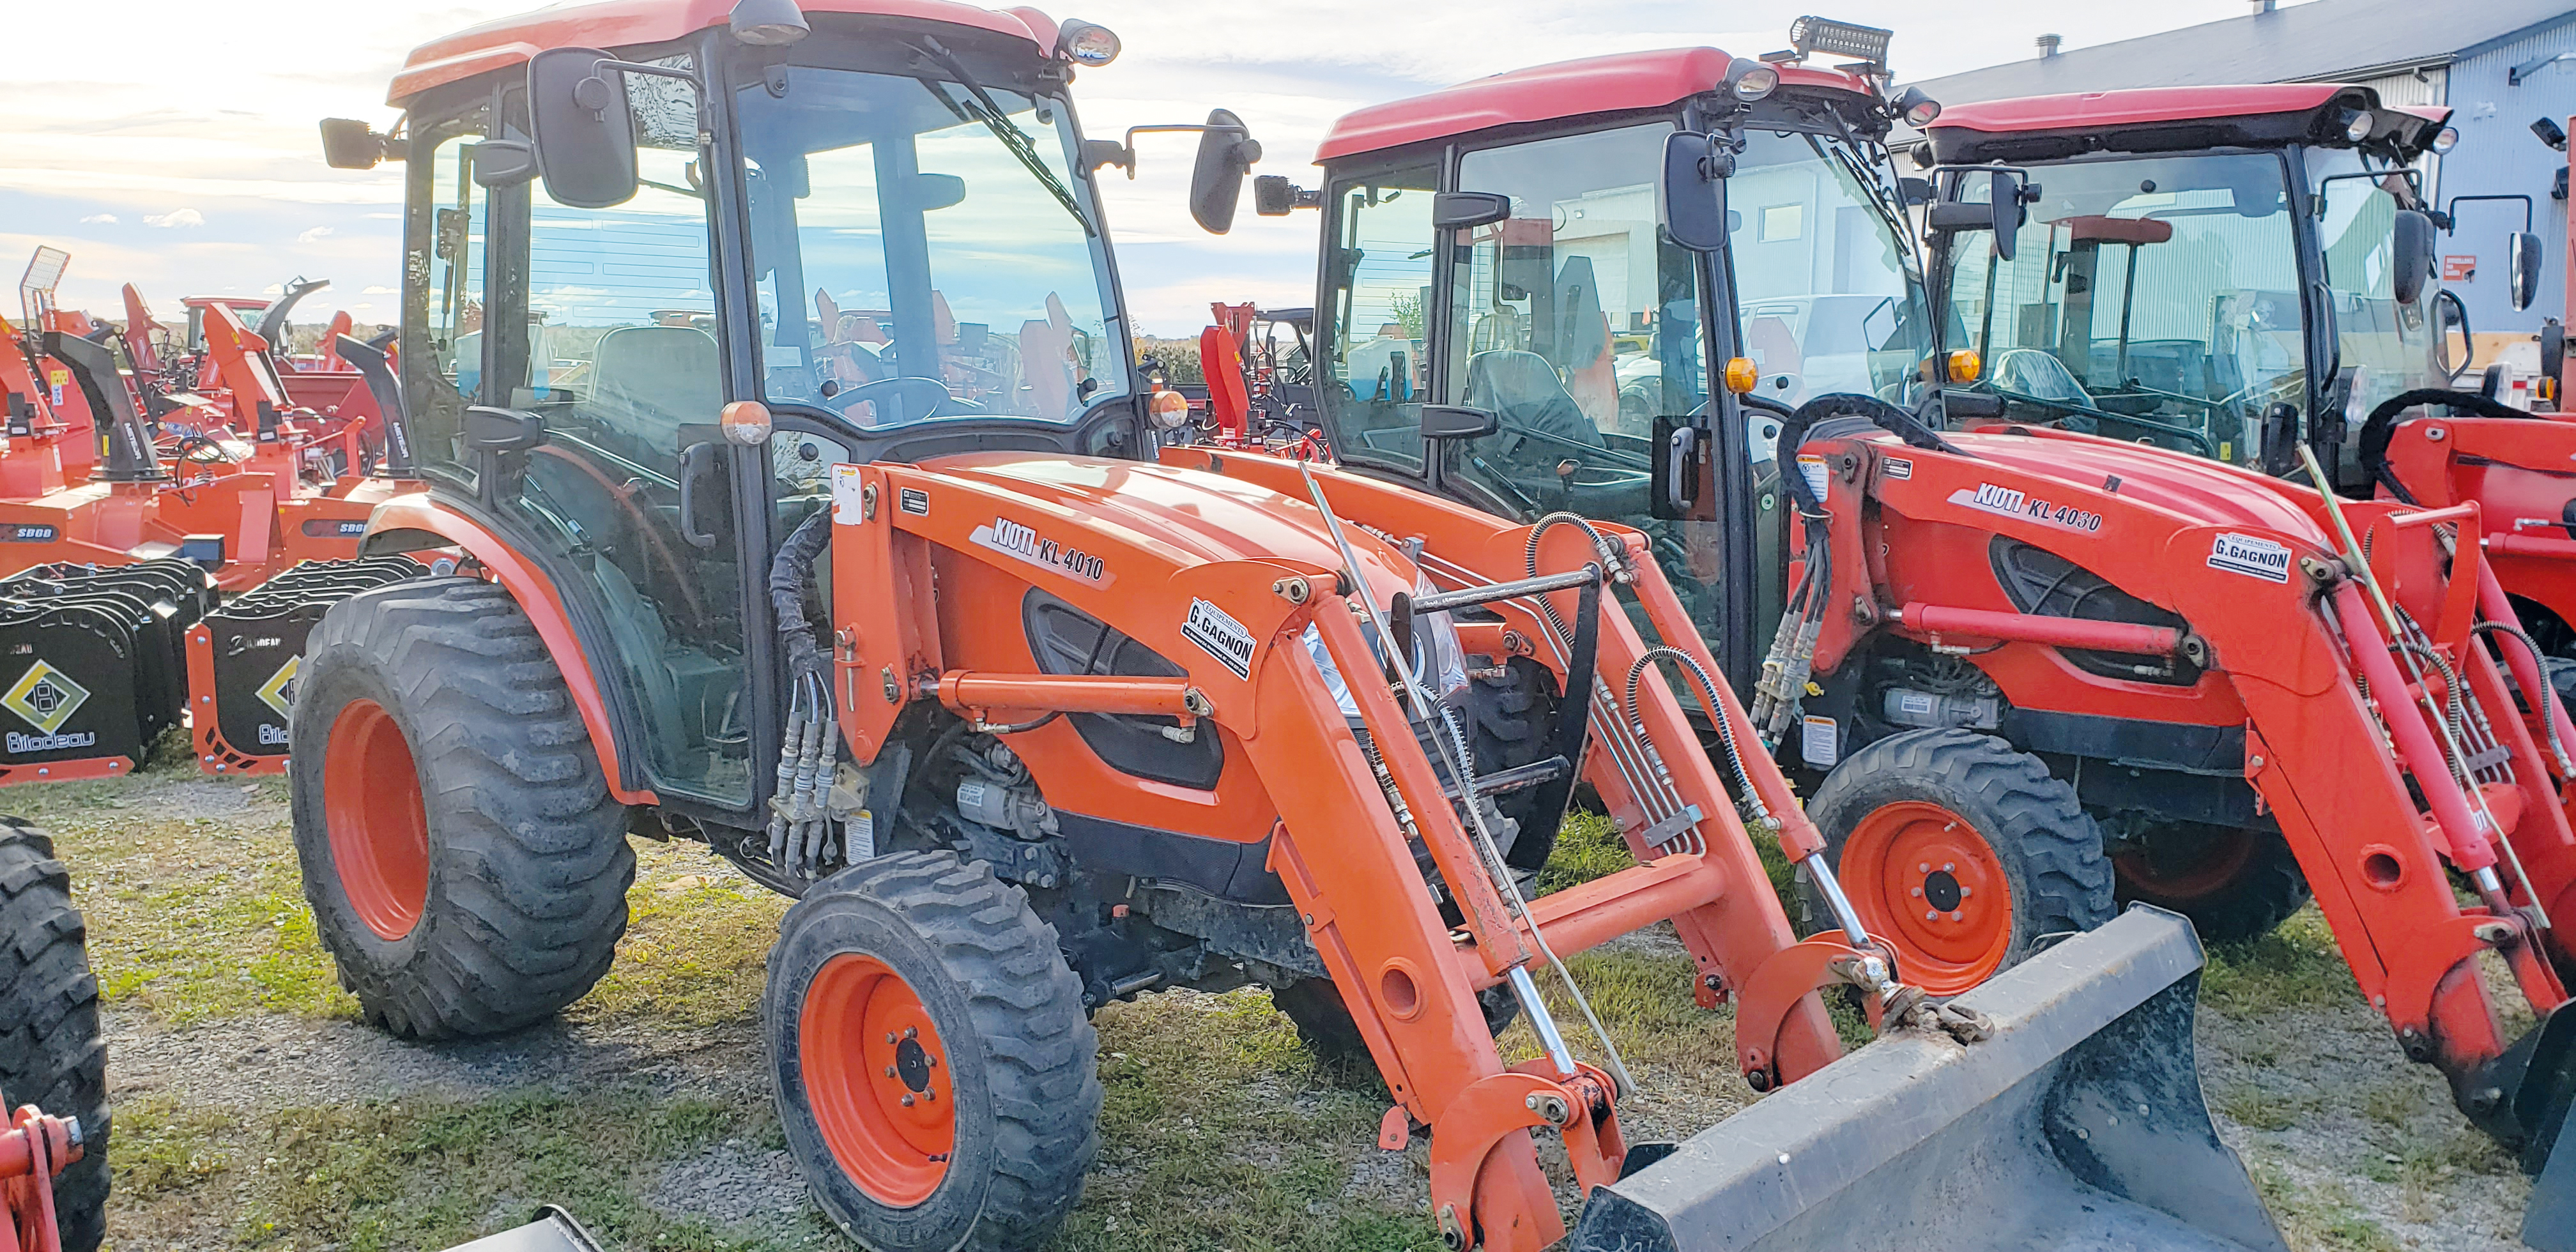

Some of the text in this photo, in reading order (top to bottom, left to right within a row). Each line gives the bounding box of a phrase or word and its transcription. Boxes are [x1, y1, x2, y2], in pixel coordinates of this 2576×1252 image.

[124, 422, 142, 461] METEOR
[392, 422, 409, 459] METEOR
[1974, 482, 2102, 532] KIOTI KL 4030
[992, 515, 1104, 581] KIOTI KL 4010
[6, 731, 95, 754] Bilodeau
